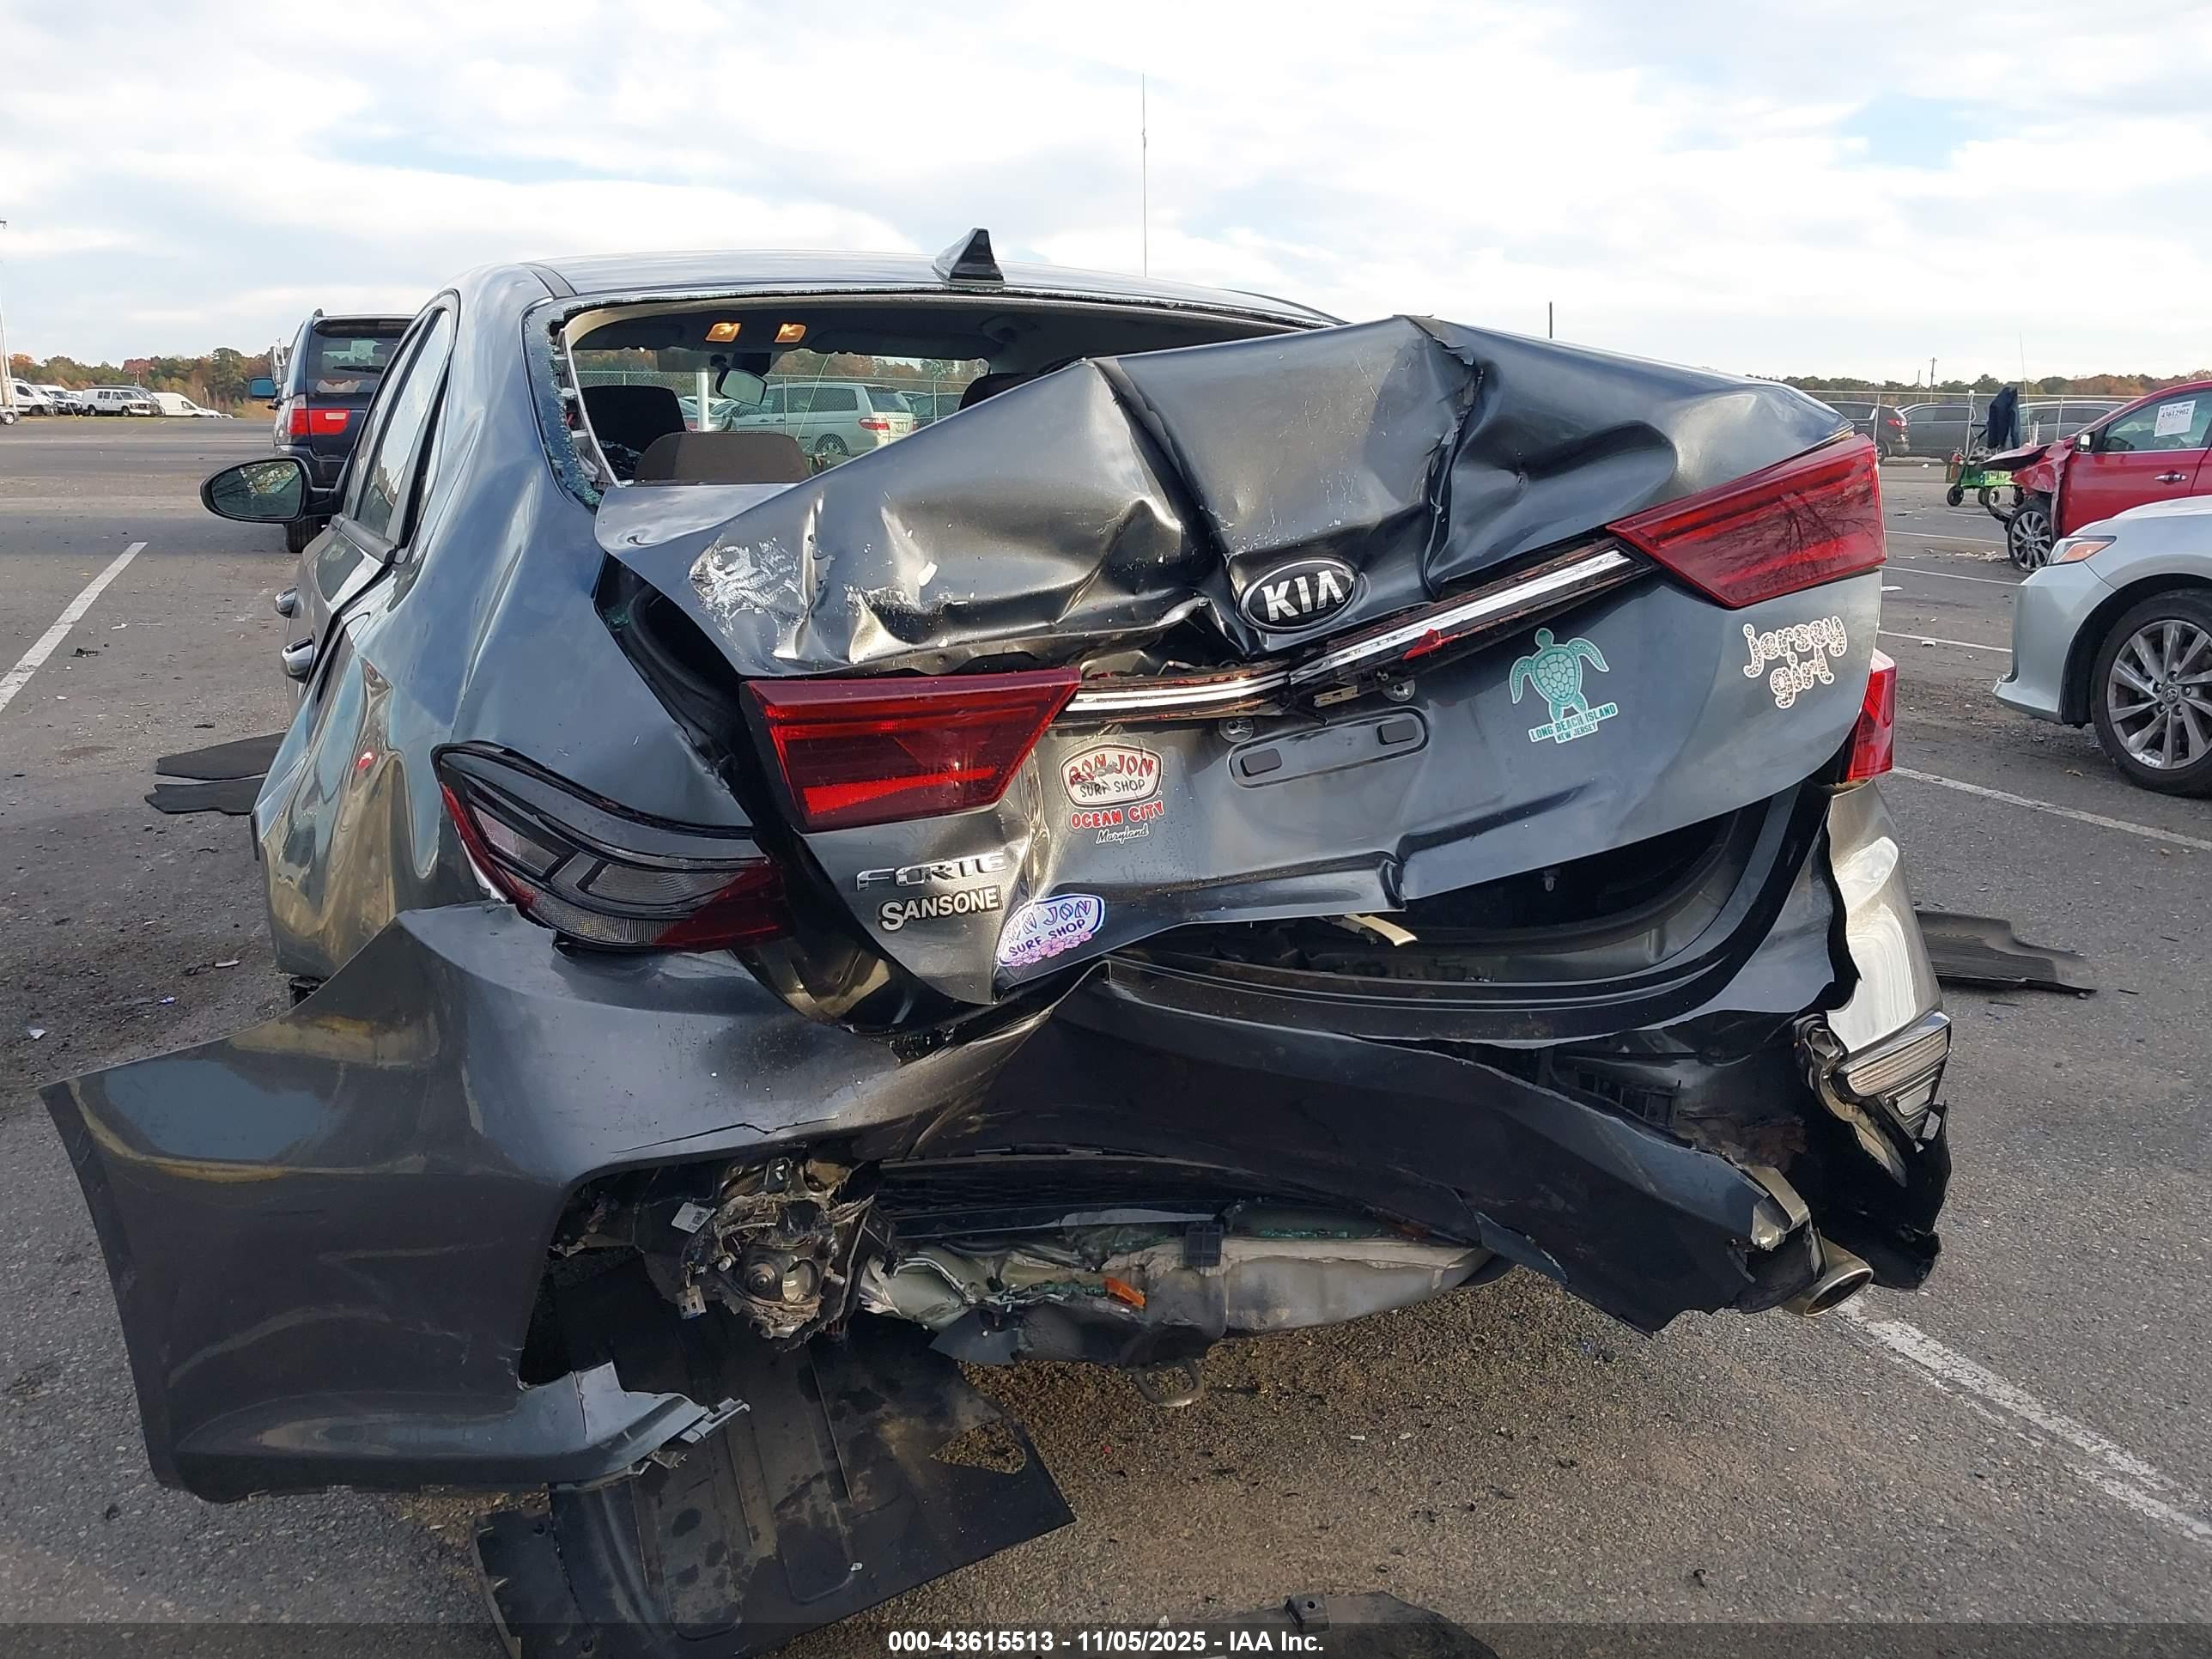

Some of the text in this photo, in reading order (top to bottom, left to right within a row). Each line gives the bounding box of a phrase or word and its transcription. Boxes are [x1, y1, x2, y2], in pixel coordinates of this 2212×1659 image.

[1261, 569, 1346, 622] KIA
[1743, 616, 1847, 678] jersey
[1770, 646, 1835, 708] girl
[1530, 704, 1616, 740] LONG BEACH ISLAND
[1557, 722, 1597, 742] NEW JERSEY
[1069, 753, 1154, 788] RON JON
[1113, 779, 1146, 793] SHOP
[1071, 800, 1164, 829] OCEAN CITY
[1096, 823, 1149, 844] Maryland
[856, 851, 1007, 891] FORTE
[880, 888, 1000, 932] SANSONE
[1042, 900, 1091, 926] JON
[1008, 919, 1086, 957] SURF SHOP
